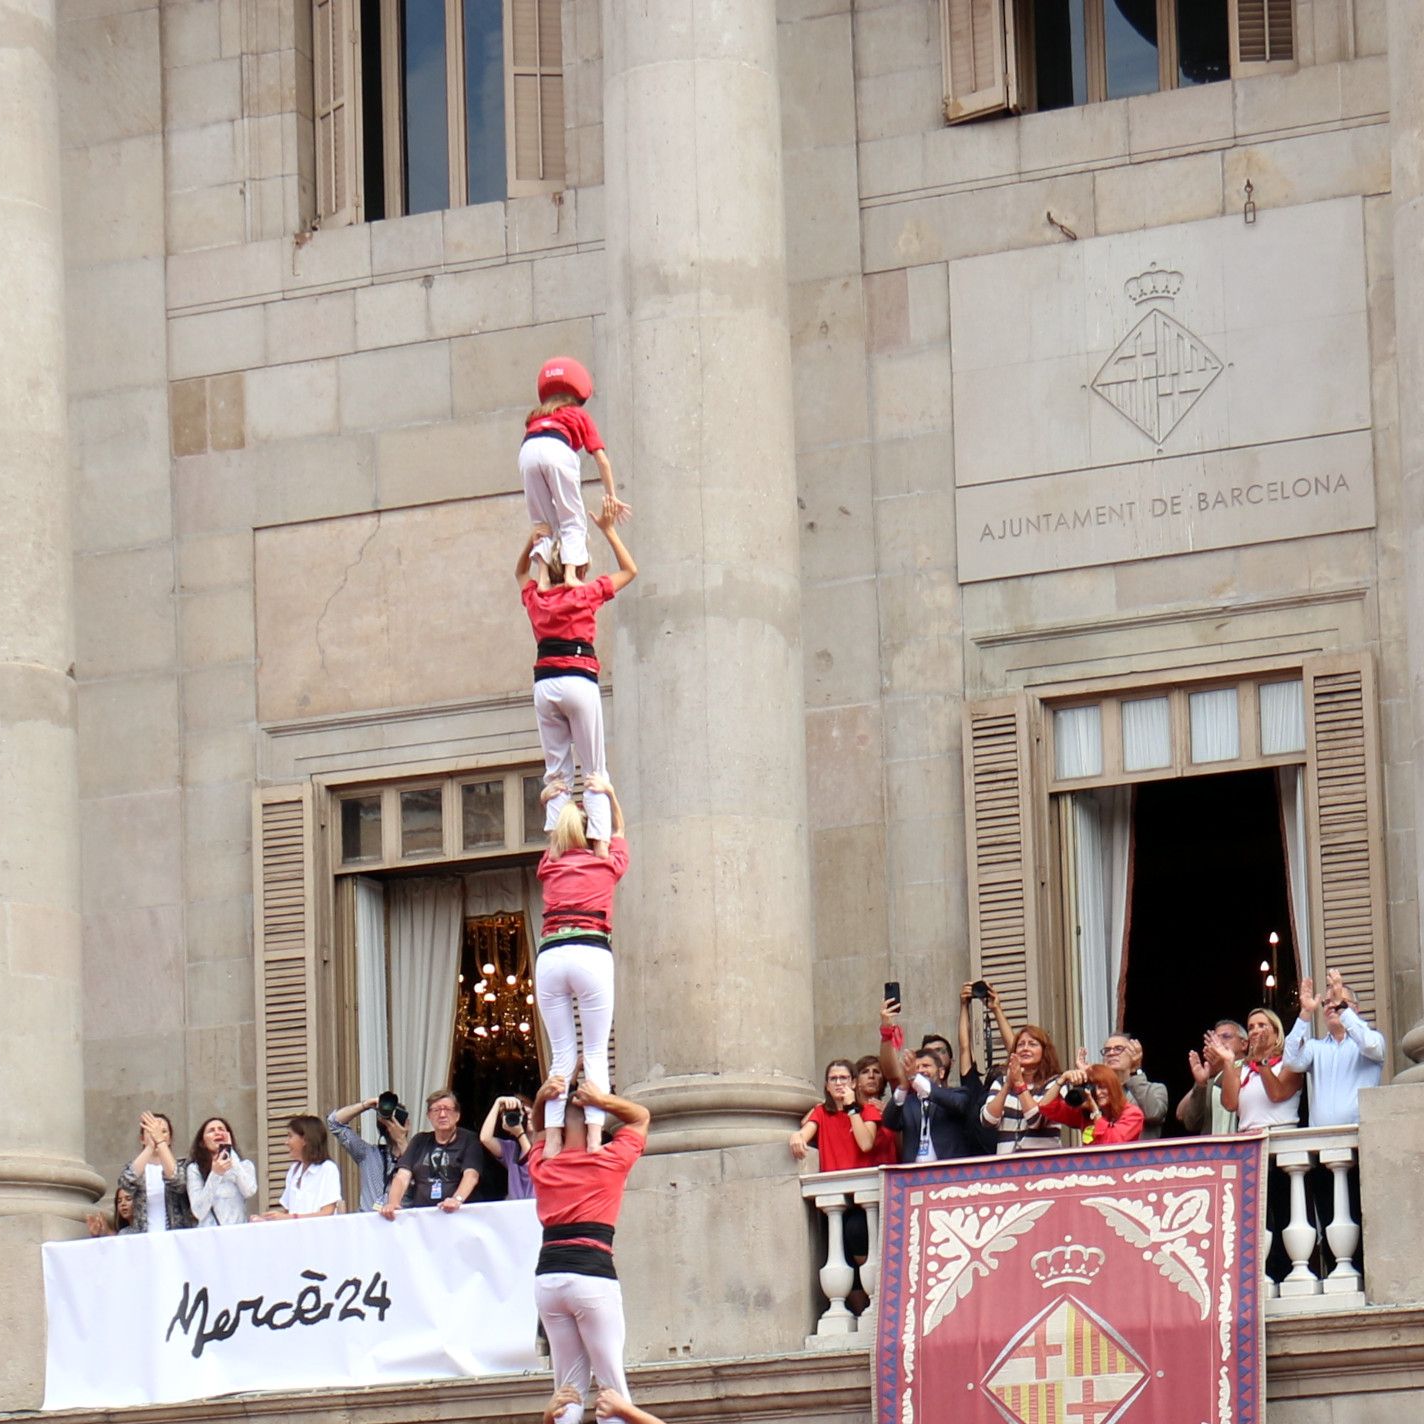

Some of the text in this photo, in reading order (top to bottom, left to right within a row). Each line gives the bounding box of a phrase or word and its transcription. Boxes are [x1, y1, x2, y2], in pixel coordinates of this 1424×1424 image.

[979, 473, 1350, 542] AJUNTAMENT DE BARCELONA
